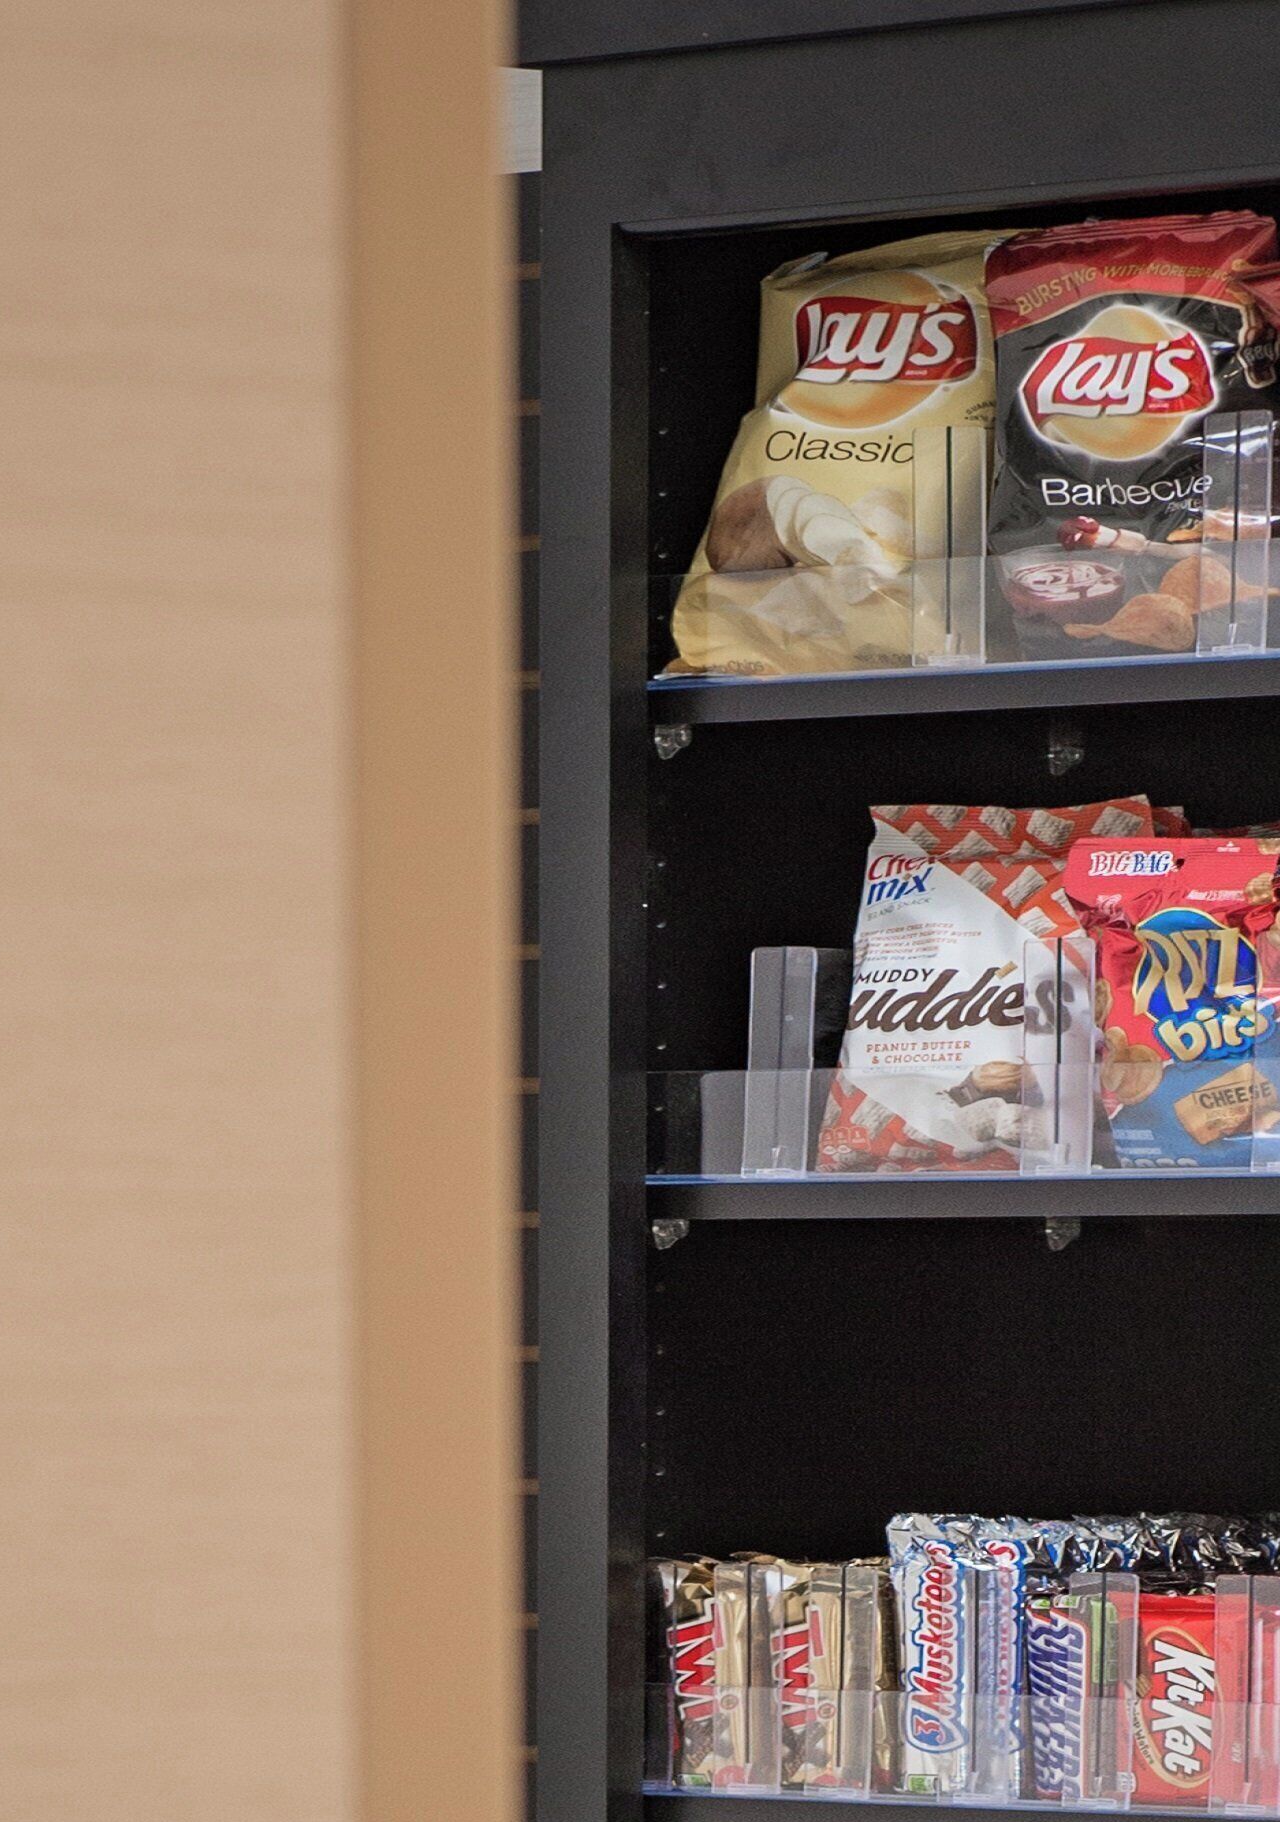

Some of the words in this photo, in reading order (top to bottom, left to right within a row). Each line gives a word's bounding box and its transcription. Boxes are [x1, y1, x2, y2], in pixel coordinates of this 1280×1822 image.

[794, 302, 967, 384] Lay's
[1036, 340, 1195, 417] Lay's
[765, 430, 914, 463] Classic
[1041, 474, 1214, 506] Barbecue
[1090, 853, 1131, 875] BIG
[1132, 852, 1171, 873] BAG
[855, 967, 935, 984] MUDDY
[846, 967, 1076, 1034] uddies
[866, 1042, 917, 1053] PEANUT
[922, 1040, 972, 1051] BUTTER
[871, 1055, 880, 1064] &
[884, 1052, 963, 1064] CHOCOLATE
[1199, 1081, 1272, 1110] CHEESE
[911, 1540, 956, 1718] Musketeers
[914, 1715, 947, 1744] 3
